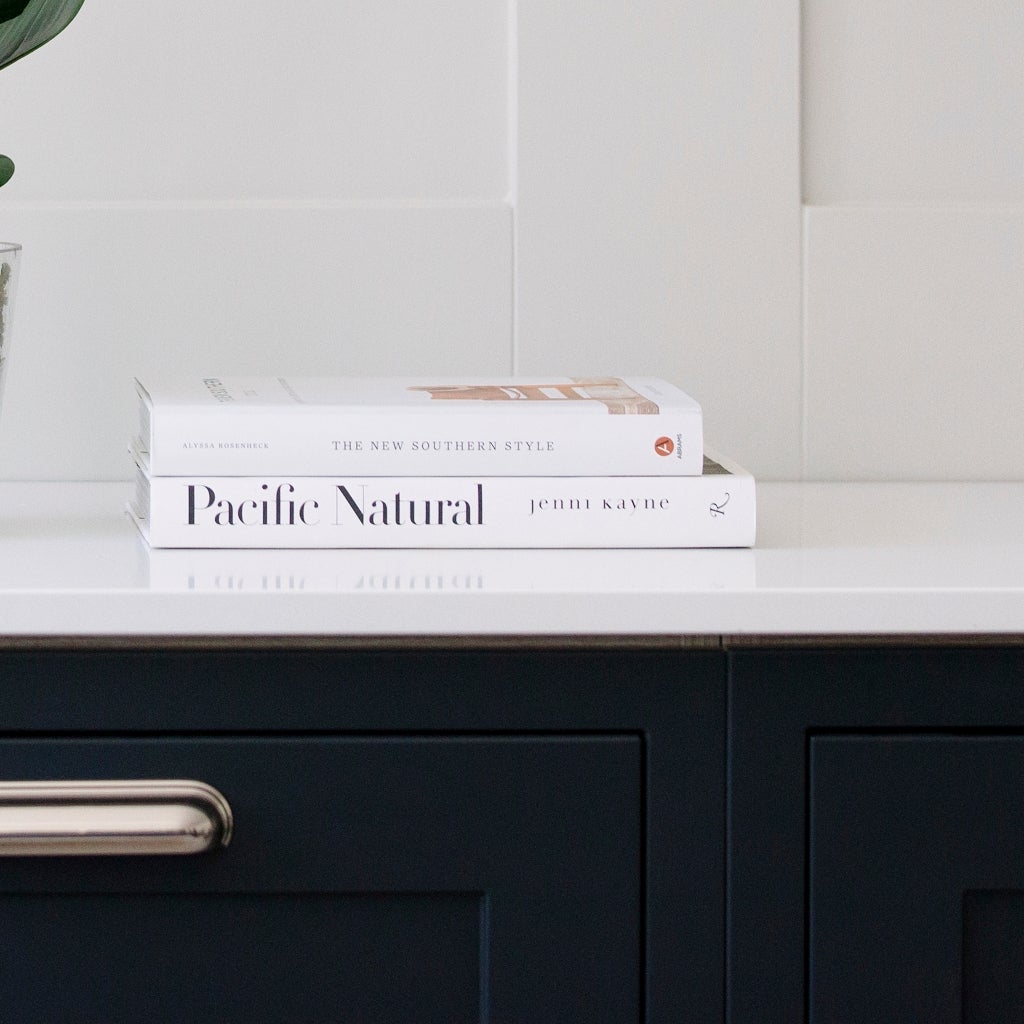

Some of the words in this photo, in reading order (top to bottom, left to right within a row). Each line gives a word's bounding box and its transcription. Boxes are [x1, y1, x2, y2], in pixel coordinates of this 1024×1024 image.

[331, 440, 364, 451] THE
[370, 440, 404, 451] NEW
[411, 440, 498, 451] SOUTHERN
[504, 440, 555, 451] STYLE
[183, 483, 320, 526] Pacific
[330, 483, 487, 526] Natural
